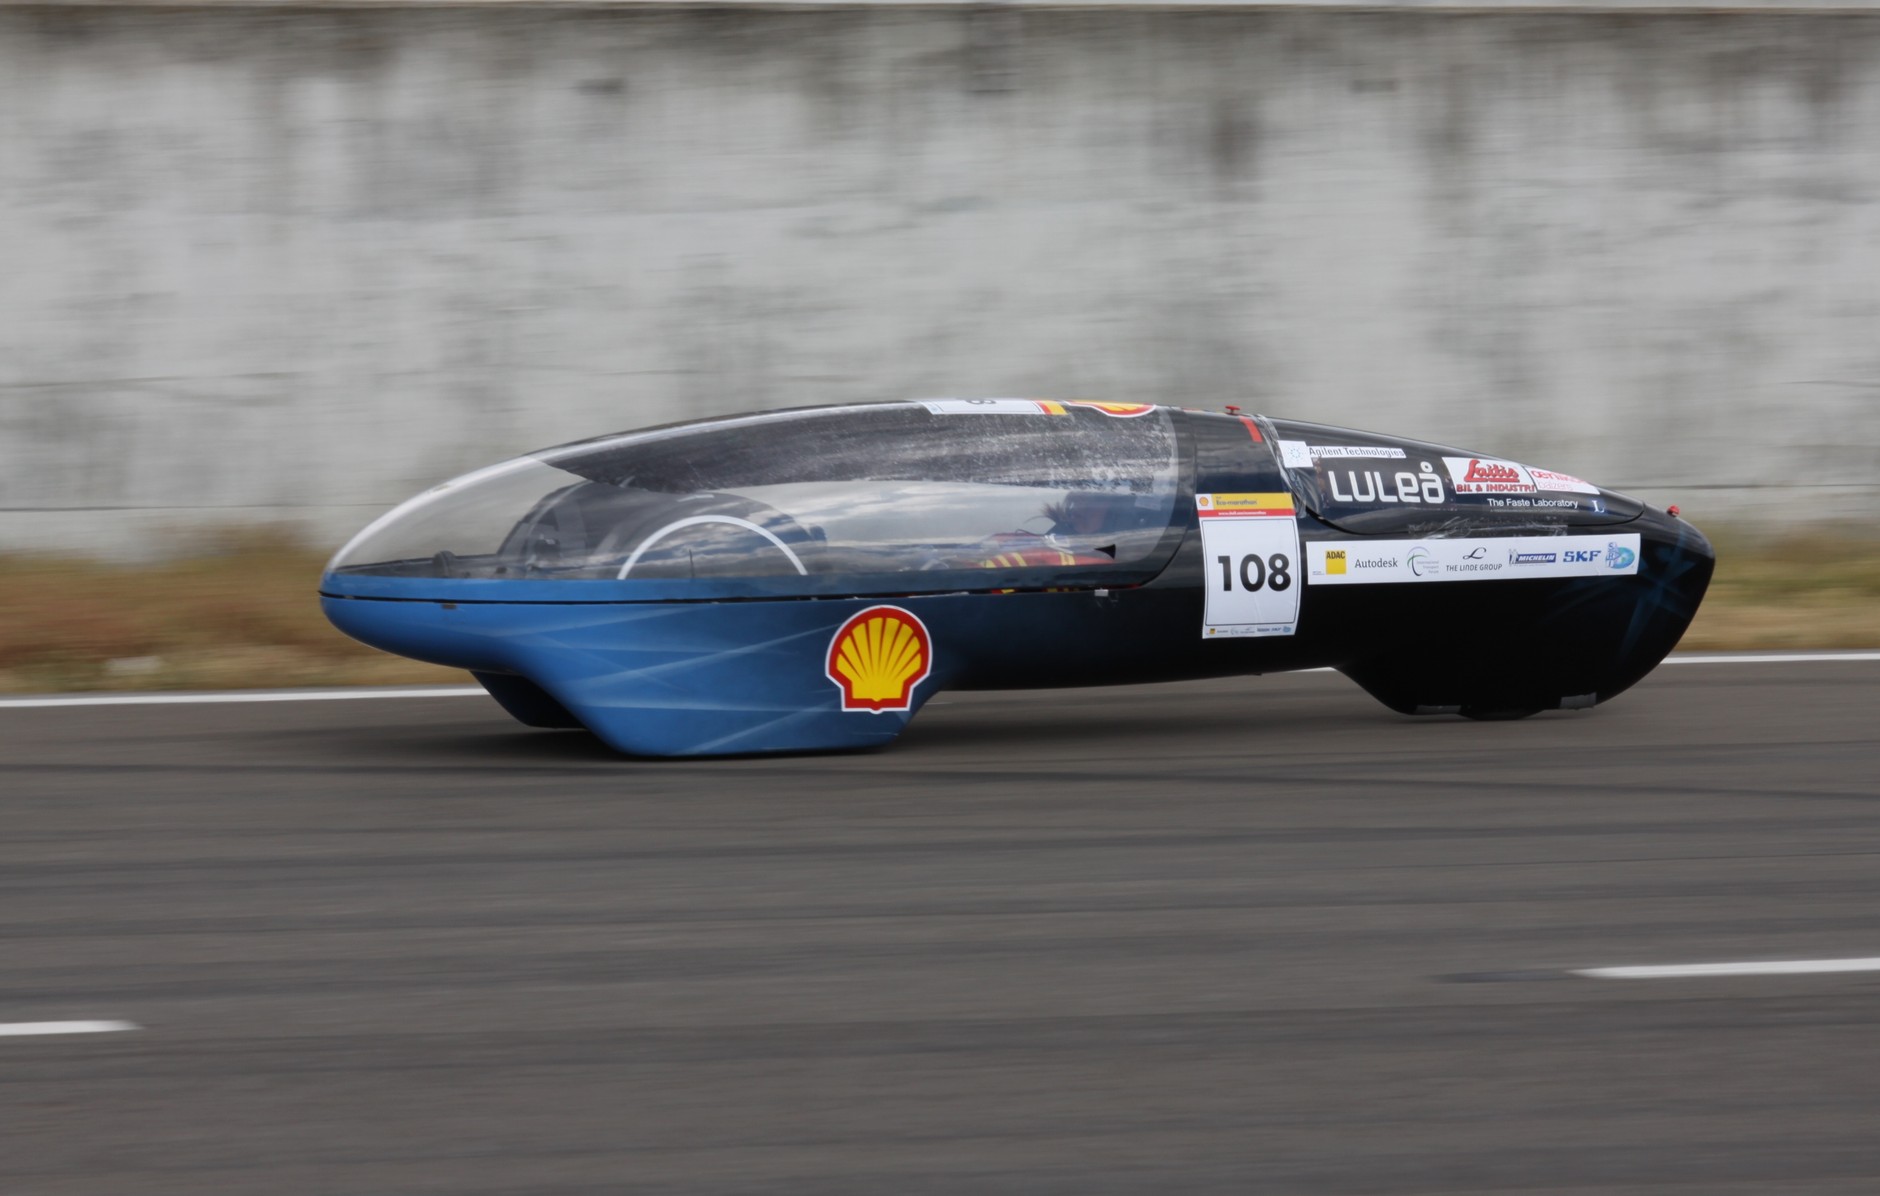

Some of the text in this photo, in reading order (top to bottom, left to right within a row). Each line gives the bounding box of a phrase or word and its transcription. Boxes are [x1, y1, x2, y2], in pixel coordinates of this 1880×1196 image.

[1309, 447, 1405, 459] Agilent Technologies
[1456, 484, 1535, 493] BIL & INDUSTRI
[1487, 498, 1579, 509] The Faste Laboratory
[1326, 550, 1346, 559] ADAC
[1517, 553, 1556, 562] MICHELIN
[1562, 550, 1602, 563] SKF
[1354, 557, 1398, 568] Autodesk
[1446, 564, 1458, 572] THE
[1479, 563, 1503, 572] GROUP
[1217, 553, 1291, 592] 108
